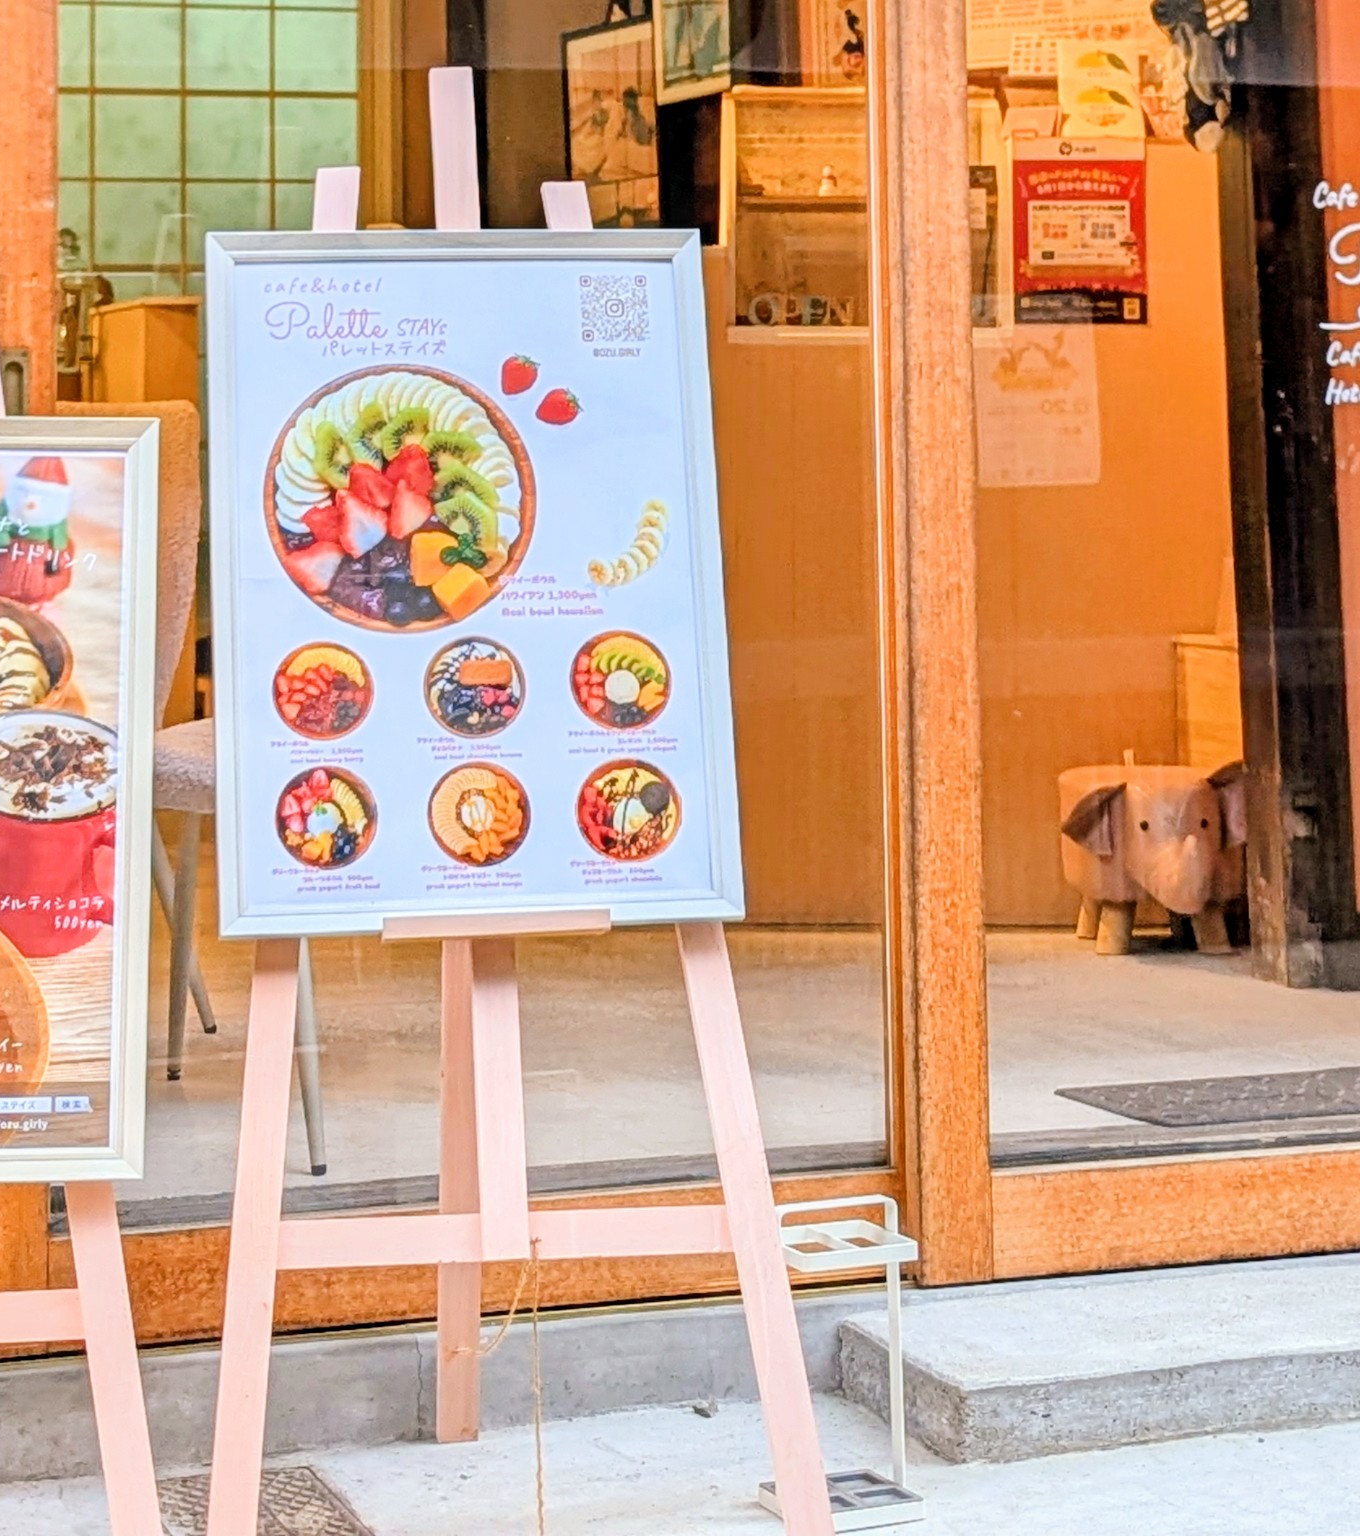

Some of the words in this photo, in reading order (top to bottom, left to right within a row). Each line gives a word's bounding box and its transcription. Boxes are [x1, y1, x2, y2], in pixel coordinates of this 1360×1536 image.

[1312, 180, 1358, 210] Cafe
[263, 276, 383, 295] cafe&hotel
[264, 300, 388, 340] Palette
[747, 292, 856, 325] OPEN
[321, 339, 447, 357] パレットステイズ
[0, 895, 105, 911] メルティショコラ
